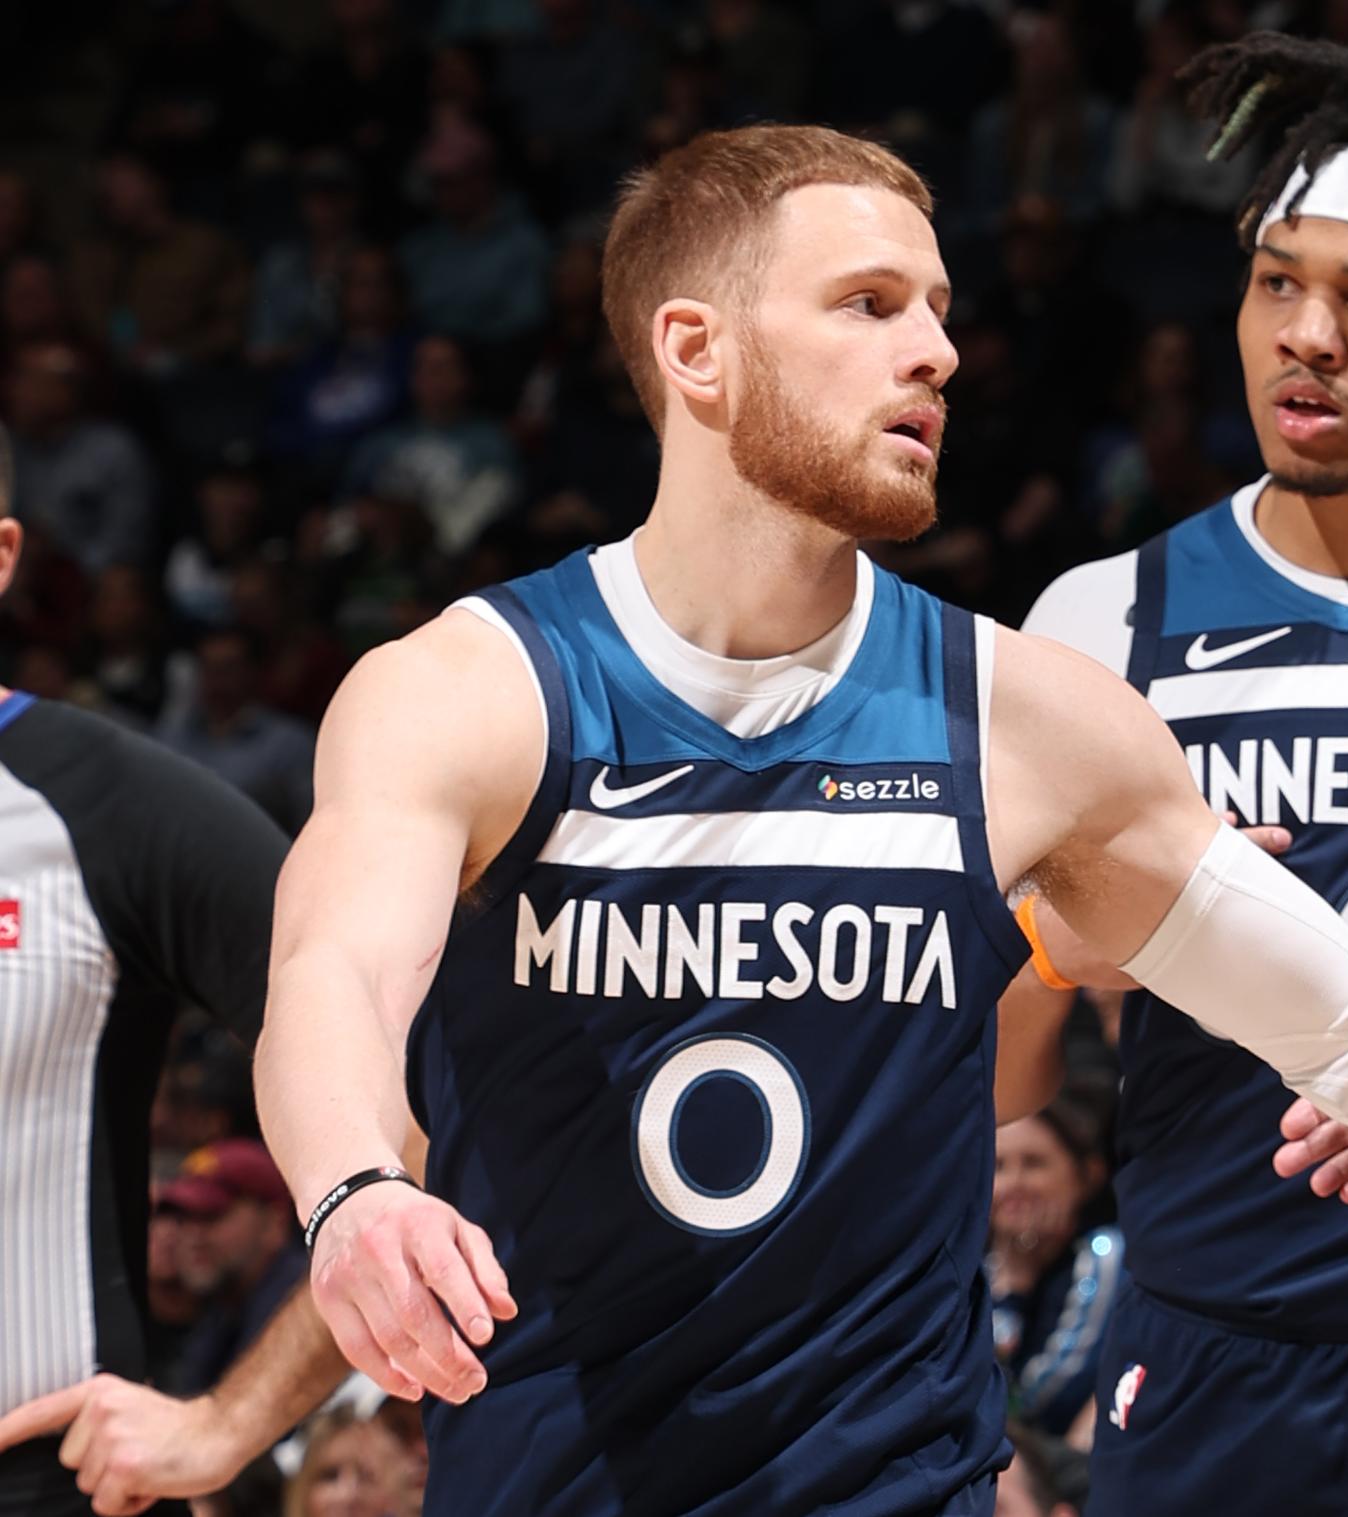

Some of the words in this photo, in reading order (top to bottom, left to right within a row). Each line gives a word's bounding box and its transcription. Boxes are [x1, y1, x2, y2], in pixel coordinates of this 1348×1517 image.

[839, 772, 940, 801] sezzle
[513, 892, 958, 1010] MINNESOTA
[631, 1033, 811, 1237] 0
